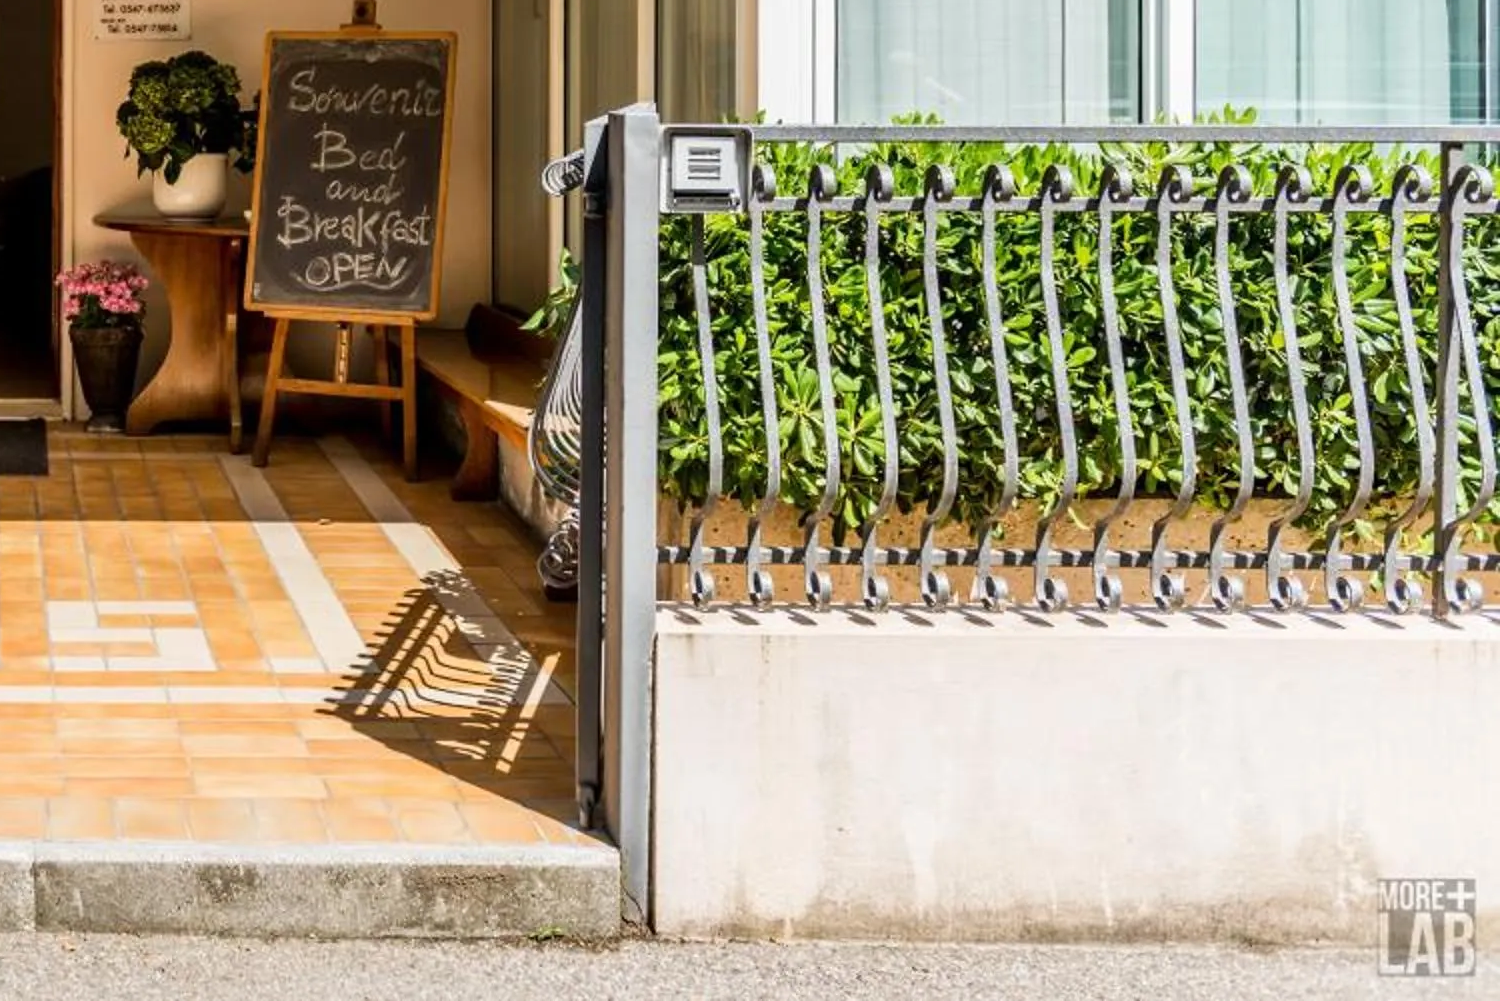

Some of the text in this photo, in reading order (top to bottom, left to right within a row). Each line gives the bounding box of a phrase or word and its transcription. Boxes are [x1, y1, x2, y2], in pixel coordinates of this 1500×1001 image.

[287, 67, 442, 117] Souvenir
[309, 122, 407, 174] Bed
[325, 173, 405, 205] and
[276, 196, 433, 253] Breakfast
[304, 251, 408, 286] OPEN
